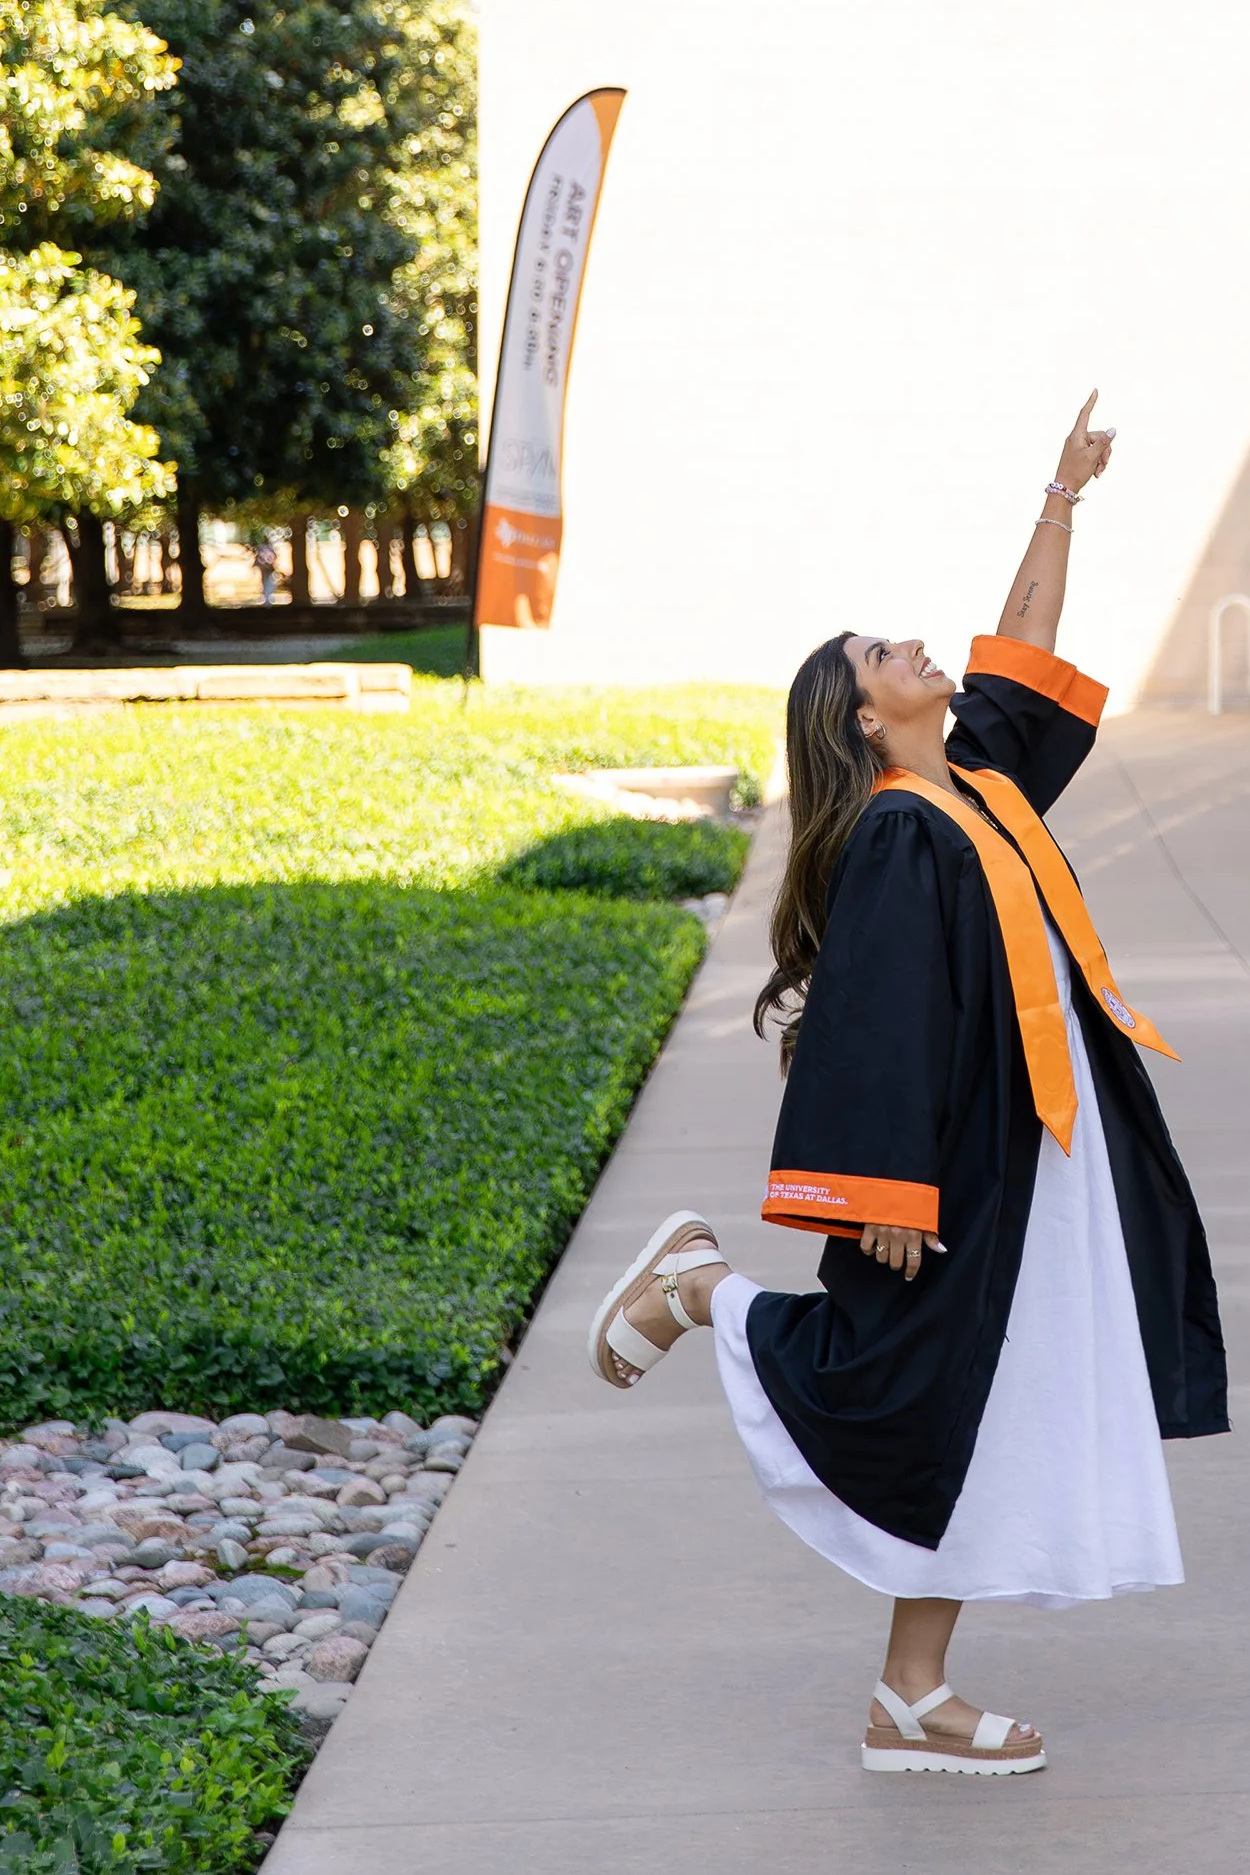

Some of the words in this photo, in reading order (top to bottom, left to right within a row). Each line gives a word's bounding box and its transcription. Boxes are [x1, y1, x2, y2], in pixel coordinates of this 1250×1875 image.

[562, 178, 586, 244] ART
[543, 247, 574, 388] OPENING
[771, 1183, 784, 1191] THE
[785, 1184, 831, 1195] UNIVERSITY
[780, 1191, 804, 1200] TEXAS
